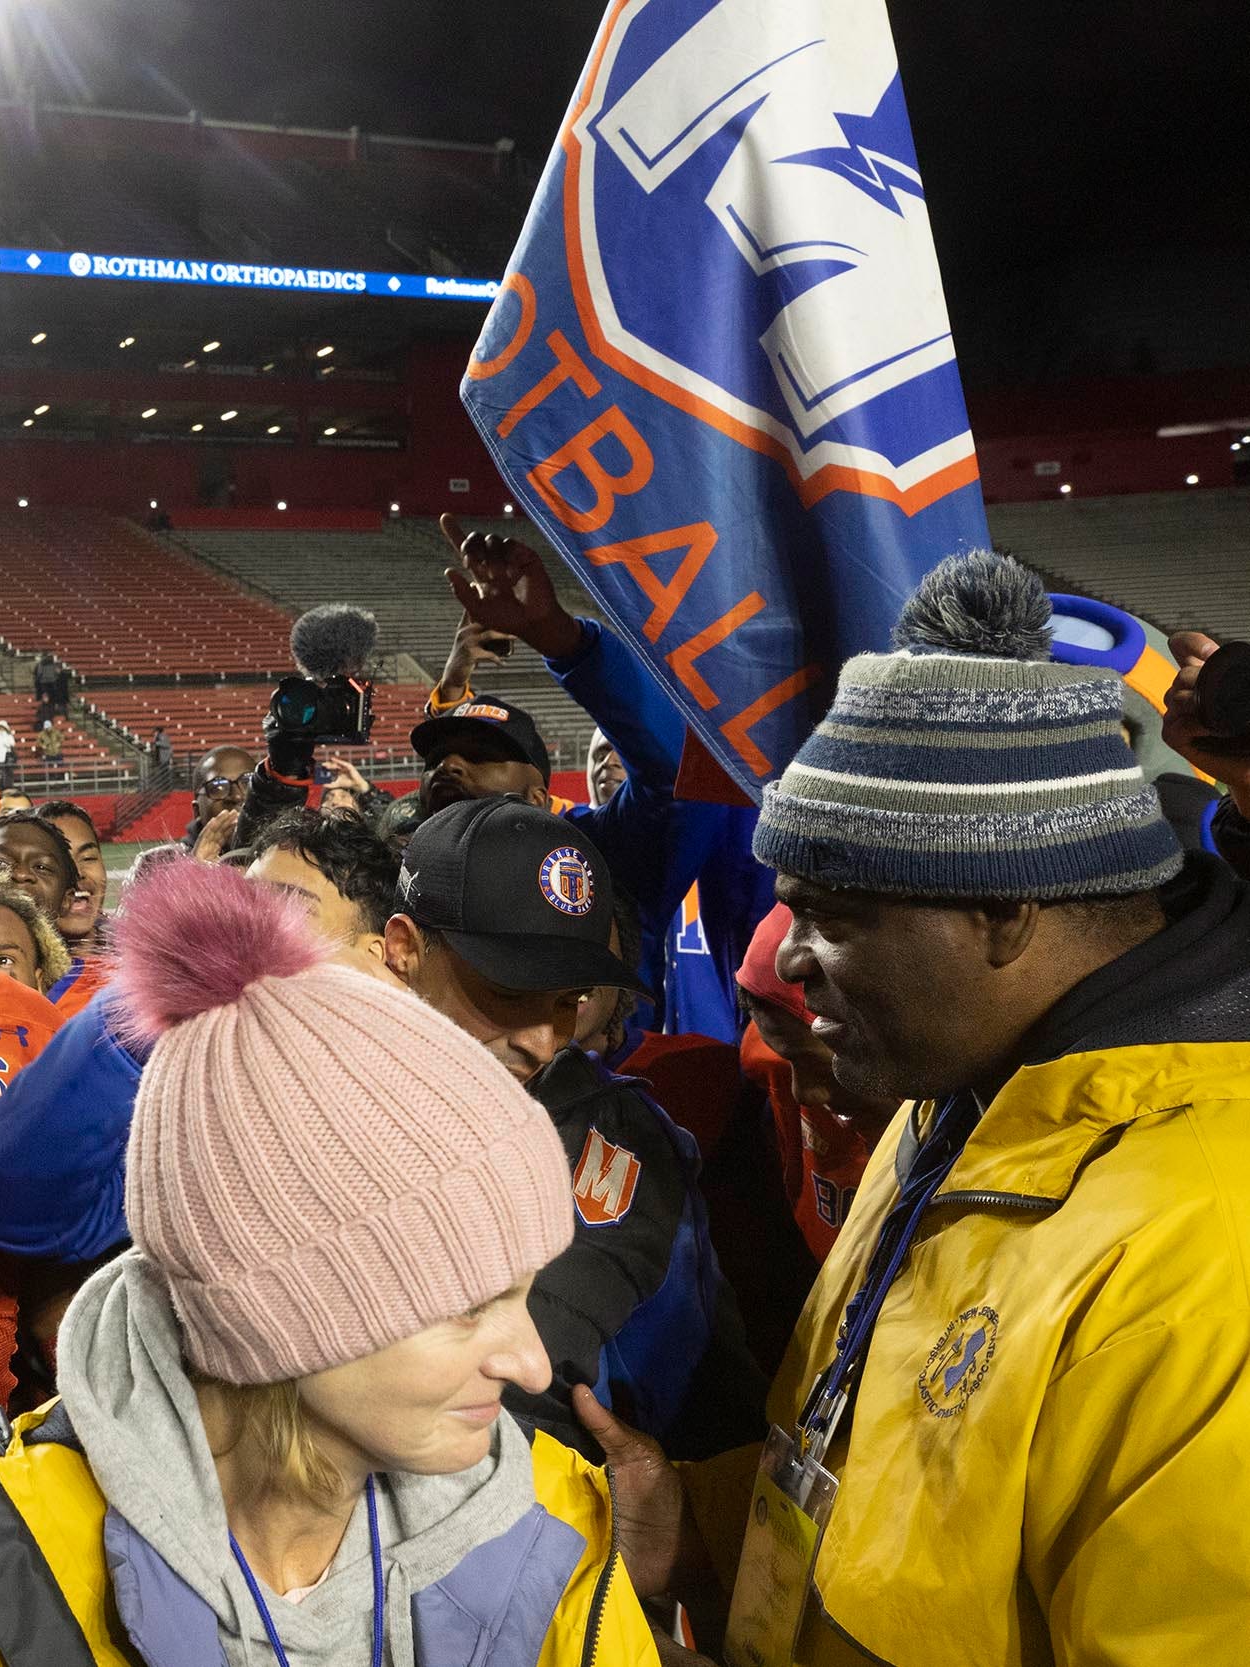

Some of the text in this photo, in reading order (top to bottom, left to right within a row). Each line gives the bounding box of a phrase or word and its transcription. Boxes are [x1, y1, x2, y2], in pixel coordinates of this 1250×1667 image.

[93, 255, 366, 291] ROTHMAN ORTHOPAEDICS
[541, 848, 579, 881] ORANGE
[549, 895, 574, 913] BLUE
